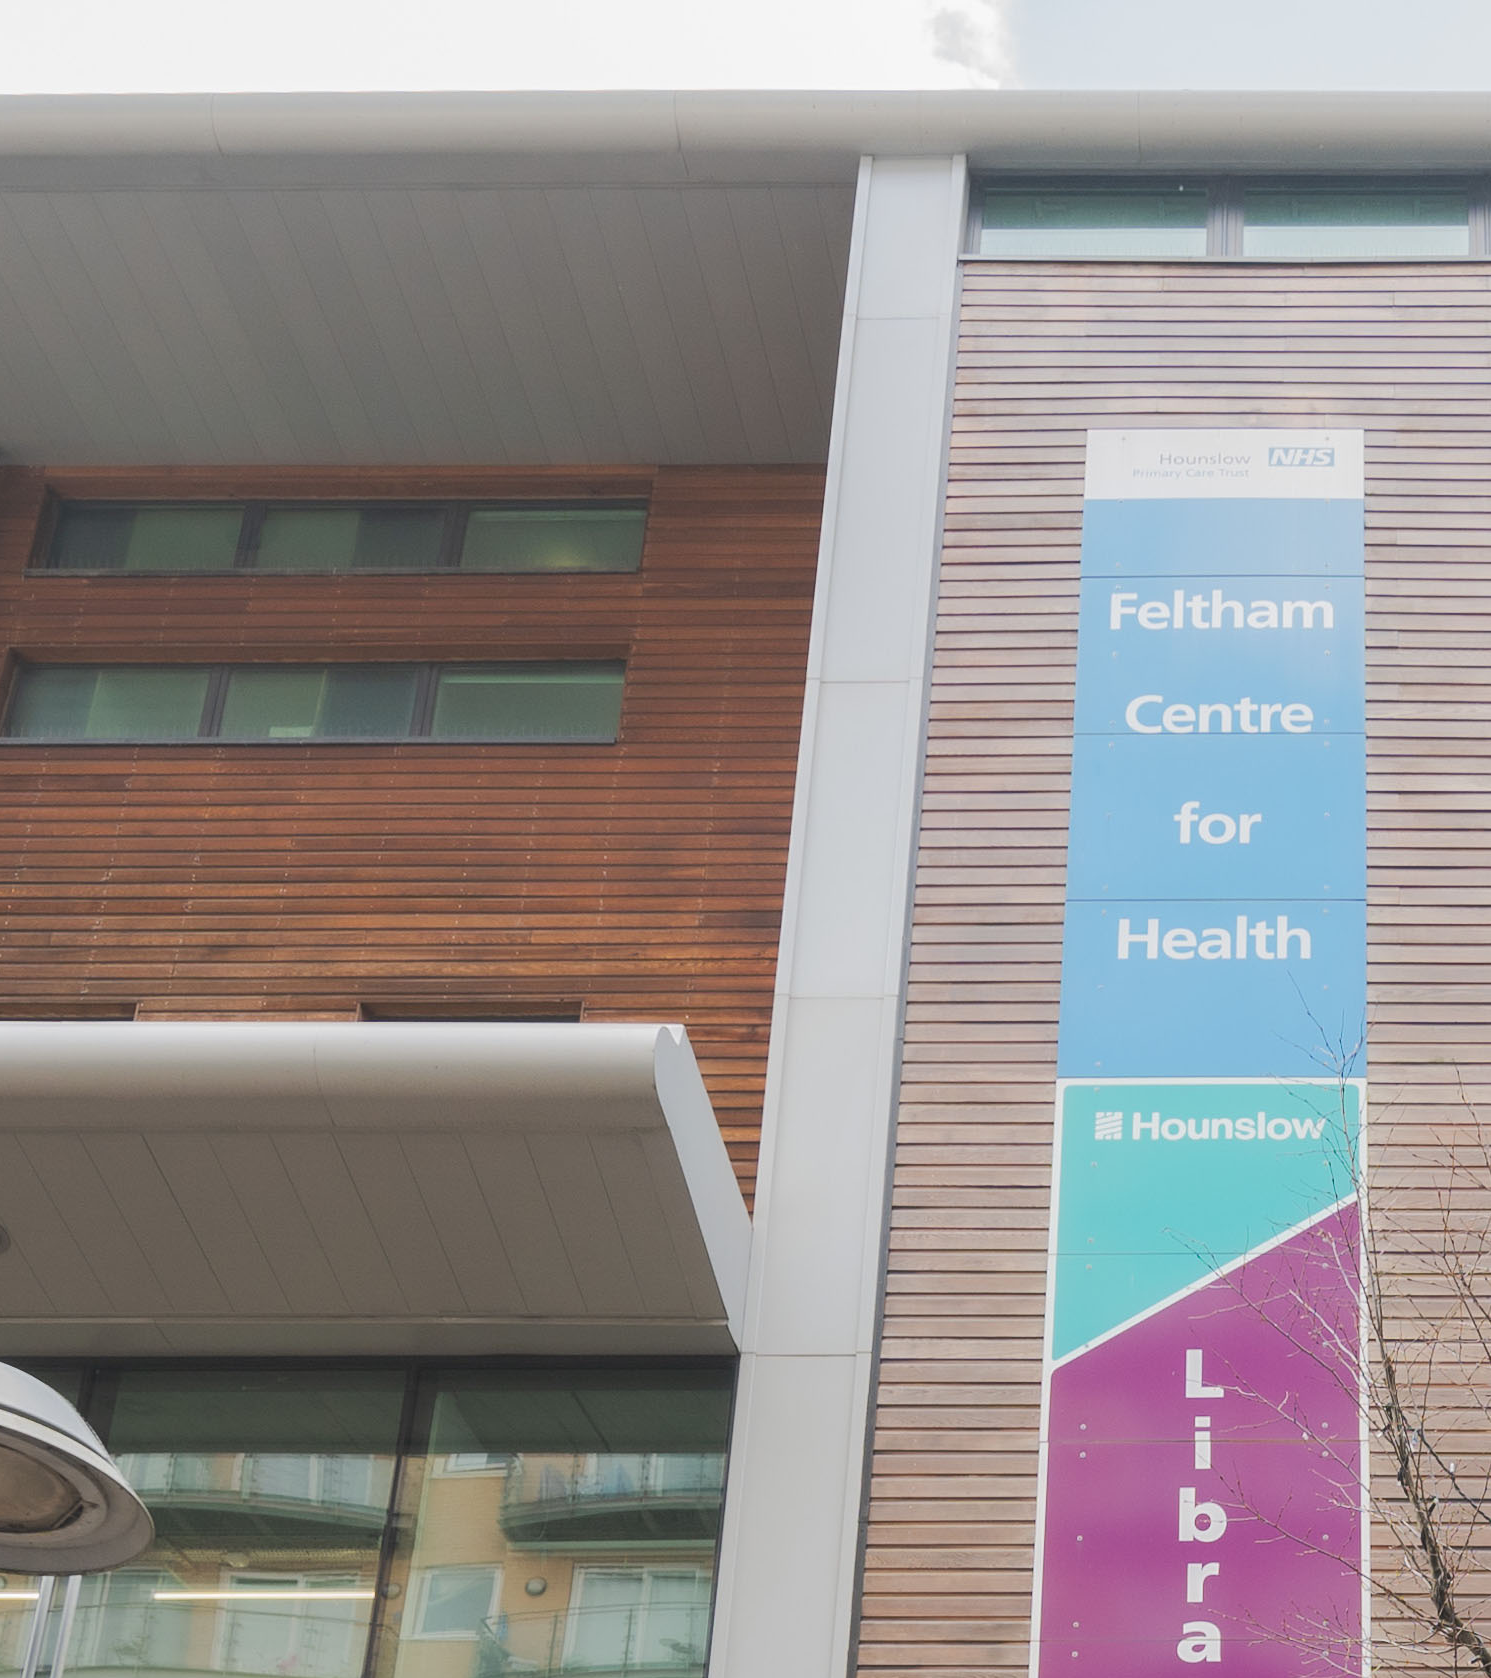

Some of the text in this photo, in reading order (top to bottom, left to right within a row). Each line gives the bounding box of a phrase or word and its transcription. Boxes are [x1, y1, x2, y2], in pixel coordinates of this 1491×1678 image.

[1133, 468, 1249, 480] Primary Care Trust
[1159, 449, 1332, 465] Hounslow NHS
[1110, 590, 1334, 629] Feltham
[1125, 695, 1313, 733] Centre
[1173, 801, 1261, 844] for
[1117, 916, 1311, 959] Health
[1132, 1111, 1327, 1141] Hounslow
